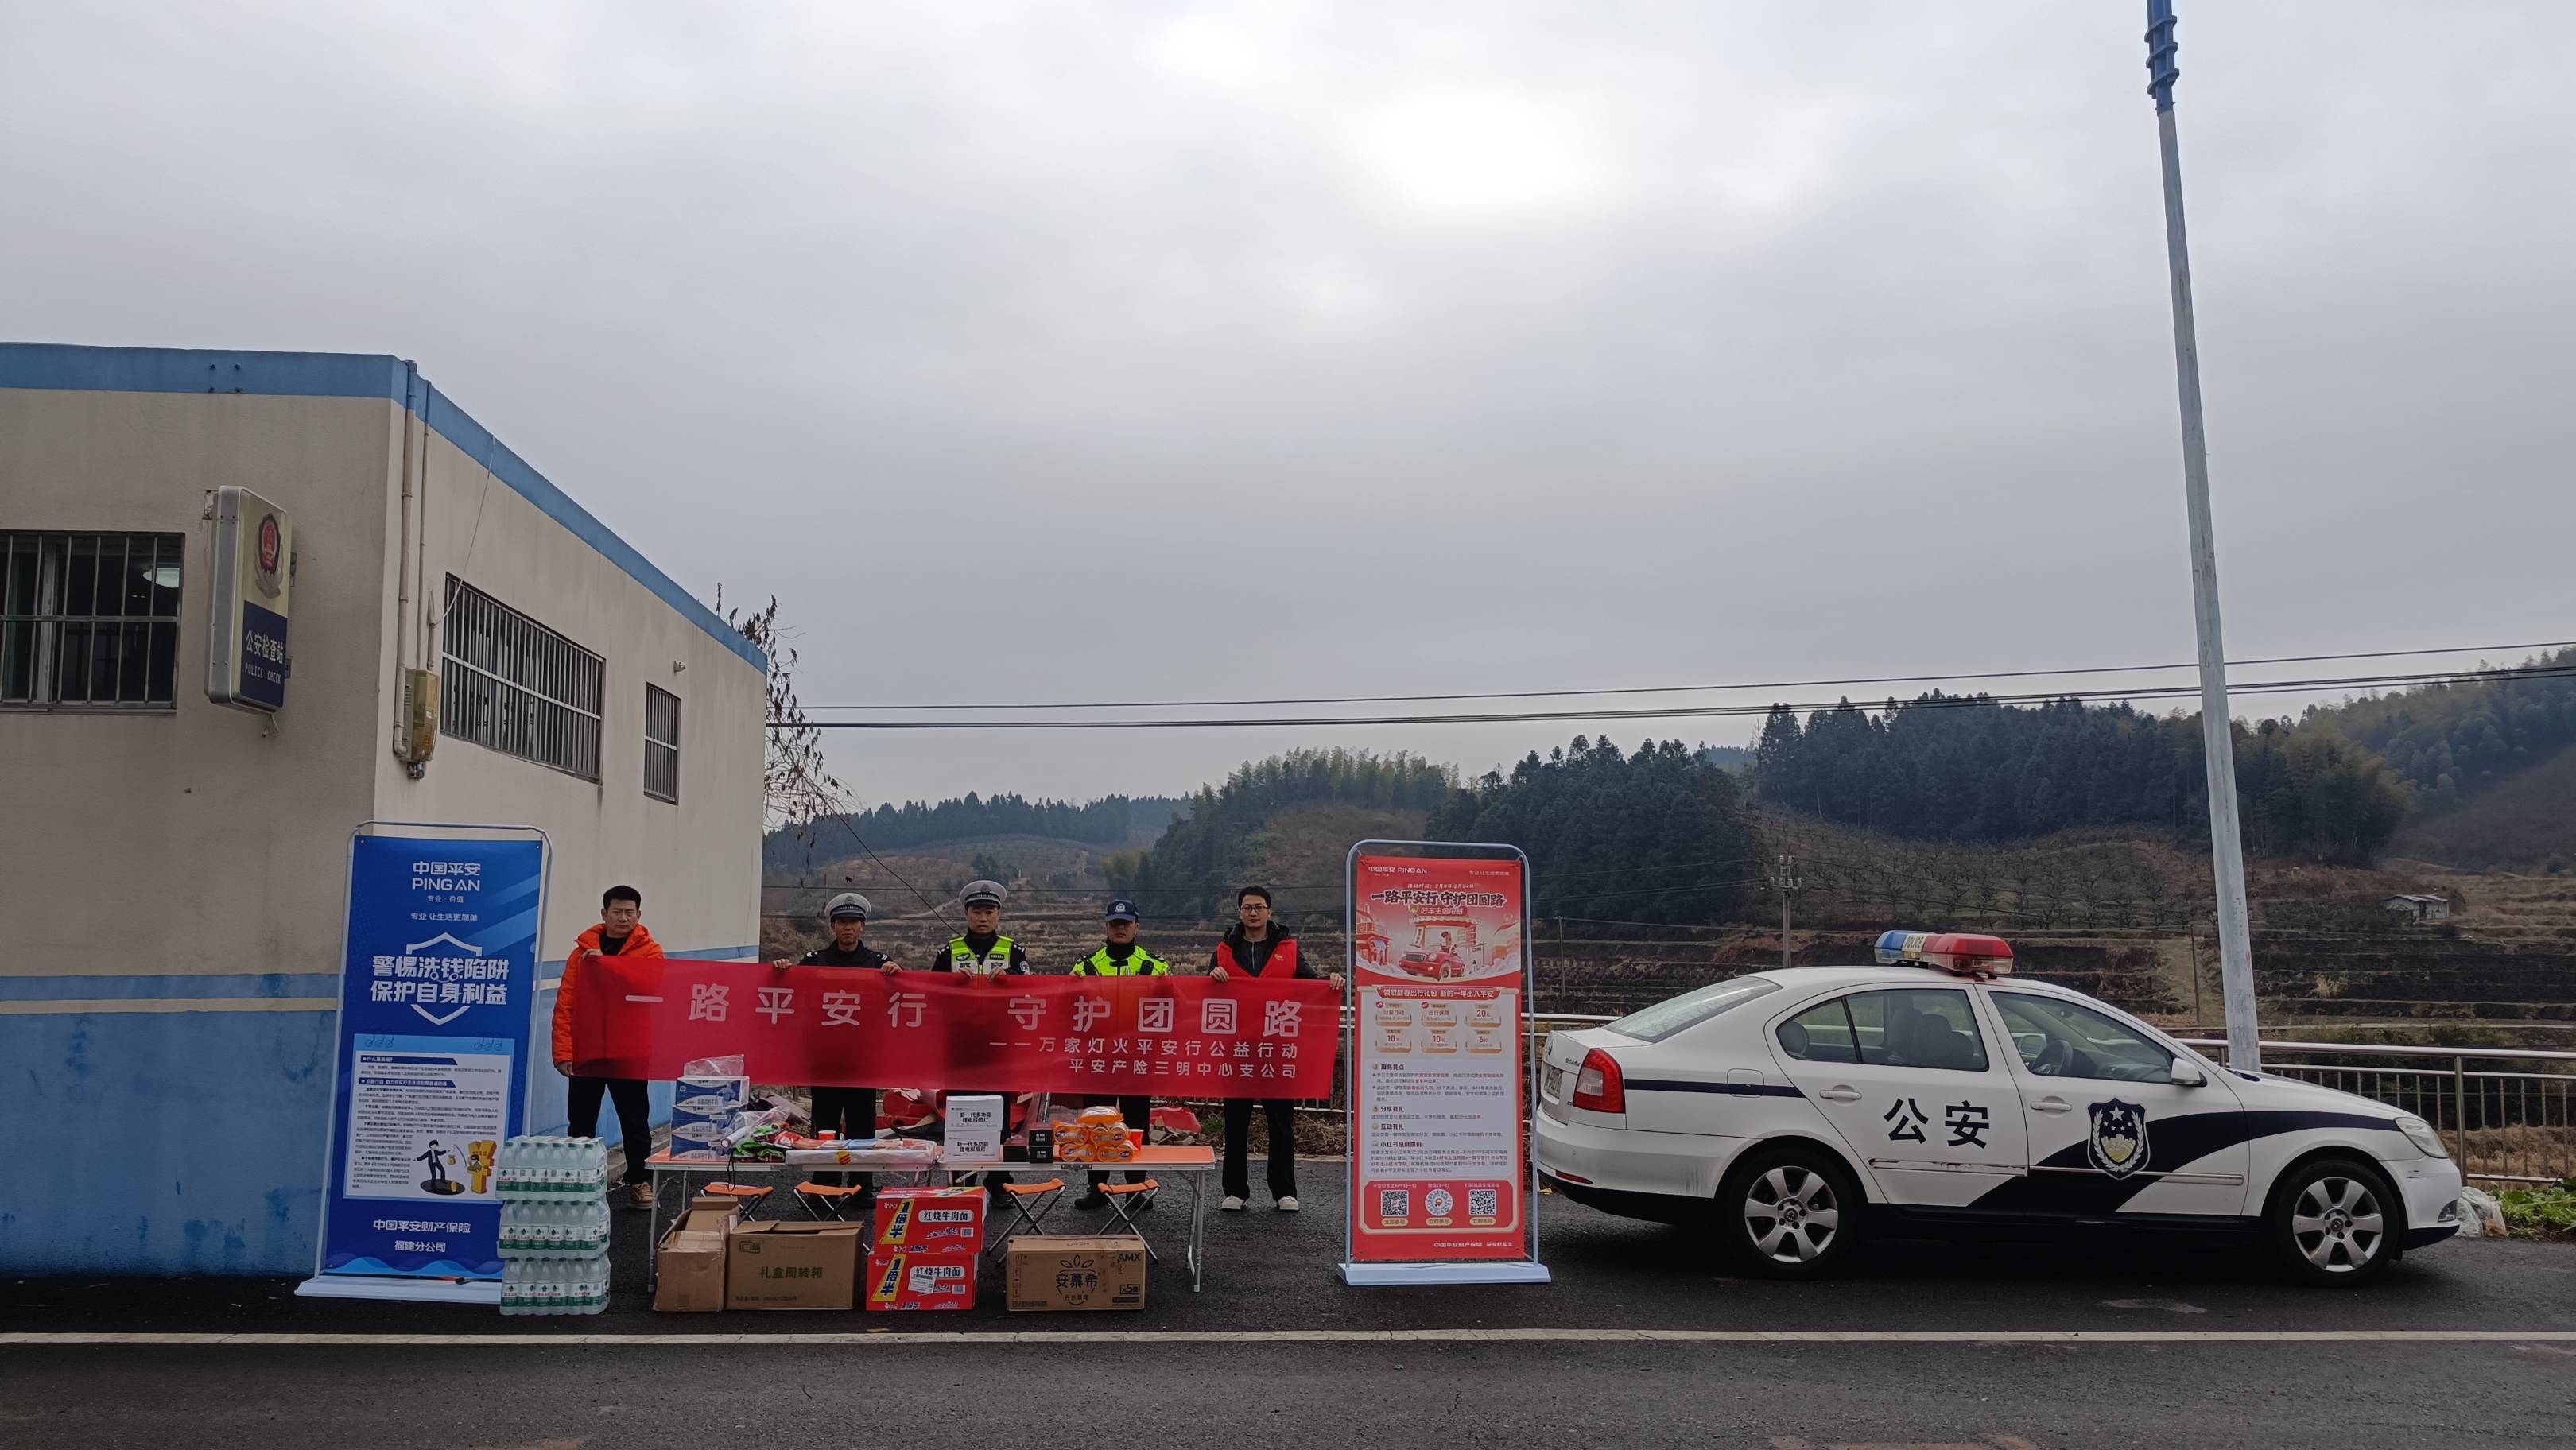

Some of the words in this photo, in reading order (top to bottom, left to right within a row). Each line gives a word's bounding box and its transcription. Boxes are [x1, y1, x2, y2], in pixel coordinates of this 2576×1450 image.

[246, 630, 283, 664] 公安检查站
[245, 662, 264, 678] POLICE
[267, 670, 281, 684] CHECK
[413, 860, 481, 876] 中国平安
[1371, 890, 1438, 905] 一路平安行
[1440, 892, 1506, 907] 守护团圆路
[372, 956, 509, 980] 警惕洗钱陷阱
[370, 980, 507, 1005] 保护自身利益
[625, 983, 927, 1028] 一路平安行
[1007, 994, 1302, 1037] 守护团圆路
[1069, 1058, 1296, 1078] 平安产险三明中心支公司
[1884, 1097, 1990, 1149] 公安
[889, 1201, 910, 1239] 1倍半
[924, 1211, 968, 1221] 红烧牛肉面
[373, 1219, 471, 1234] 中国平安财产保险
[394, 1240, 446, 1253] 福建分公司
[1118, 1253, 1141, 1262] AMX
[759, 1267, 823, 1279] 礼盒周转箱
[880, 1258, 901, 1296] 1倍半
[916, 1267, 960, 1277] 红烧牛肉面
[1056, 1273, 1098, 1288] 安慕希
